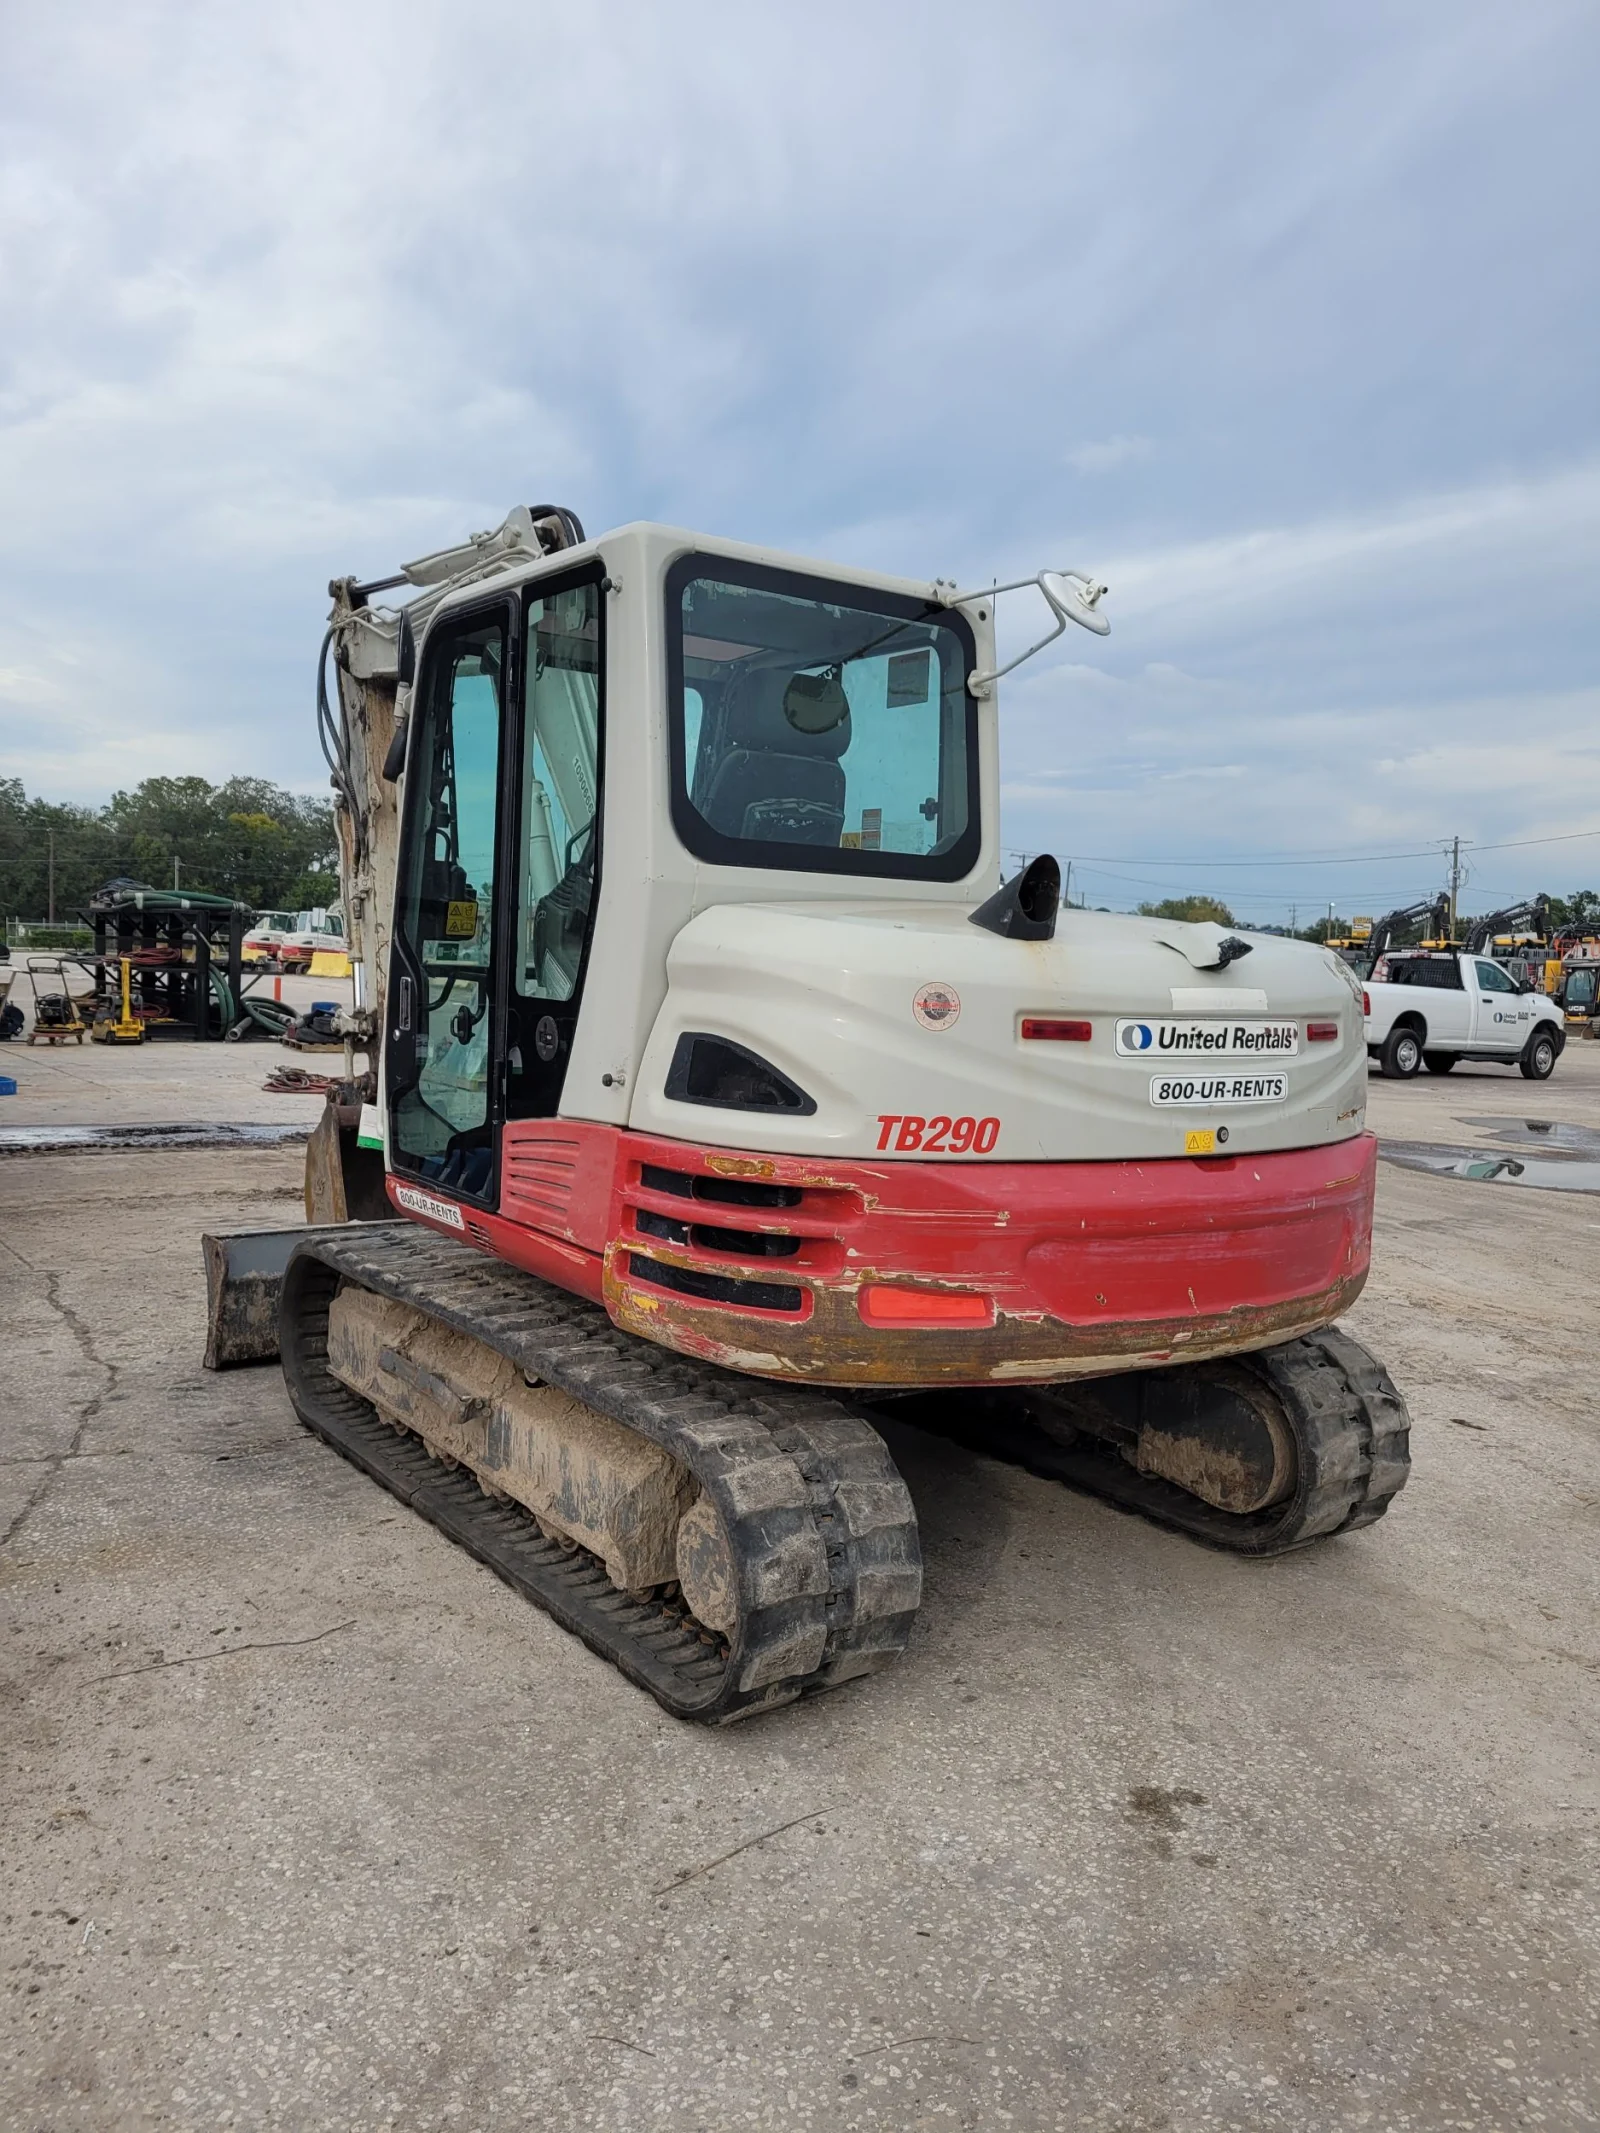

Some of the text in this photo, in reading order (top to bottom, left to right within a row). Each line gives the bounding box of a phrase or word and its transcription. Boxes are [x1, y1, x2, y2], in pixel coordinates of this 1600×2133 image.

[573, 756, 596, 816] 1090666
[1158, 1026, 1292, 1051] United Rentals
[1158, 1079, 1283, 1100] 800-UR-RENTS
[876, 1115, 1001, 1154] TB290
[400, 1190, 460, 1224] 800-UR-RENTS
